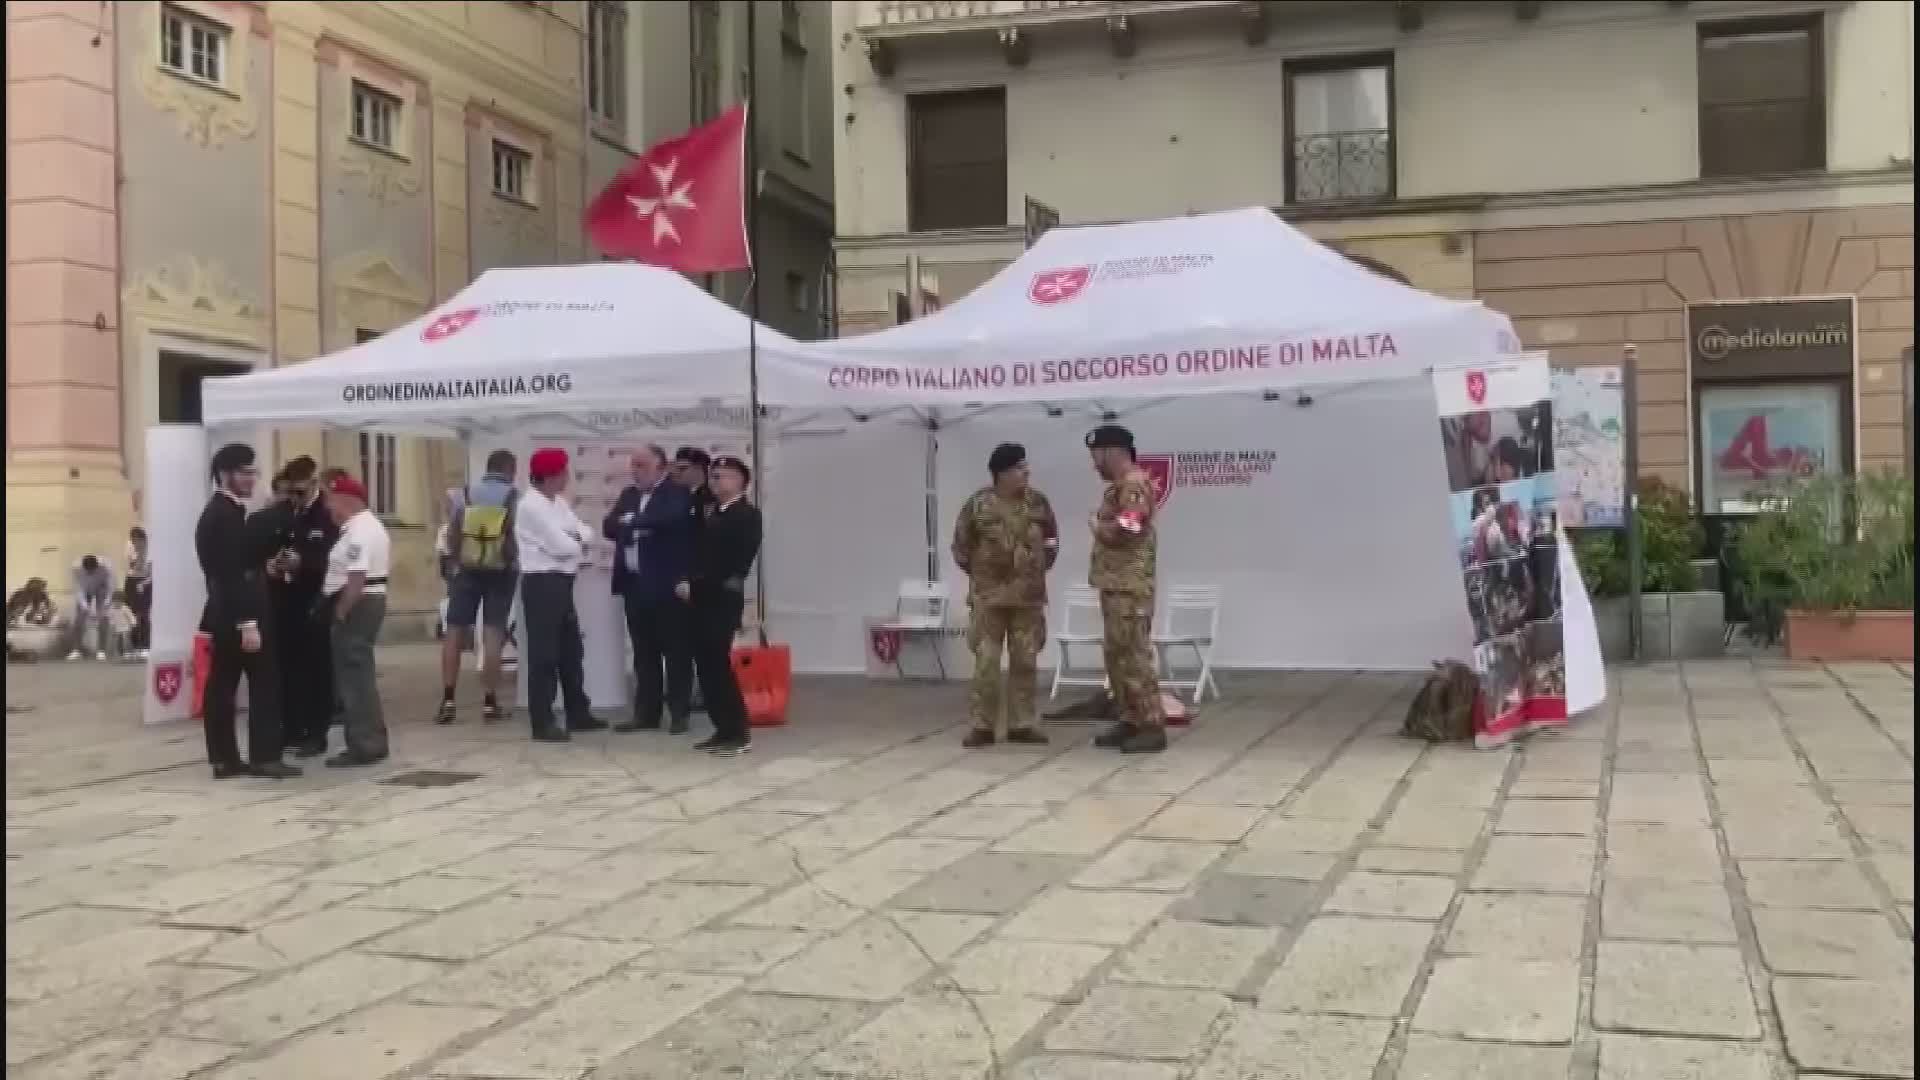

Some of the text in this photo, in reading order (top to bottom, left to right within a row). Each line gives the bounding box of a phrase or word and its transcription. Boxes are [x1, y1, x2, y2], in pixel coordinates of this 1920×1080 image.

[1698, 325, 1848, 360] mediolanum
[828, 365, 900, 390] CORPO
[1013, 362, 1036, 385] DI
[1042, 353, 1168, 384] SOCCORSO
[1176, 345, 1272, 375] ORDINE
[1279, 342, 1303, 366] DI
[1311, 332, 1398, 363] MALTA
[342, 373, 573, 402] ORDINEDIMALTAITALIA.ORG
